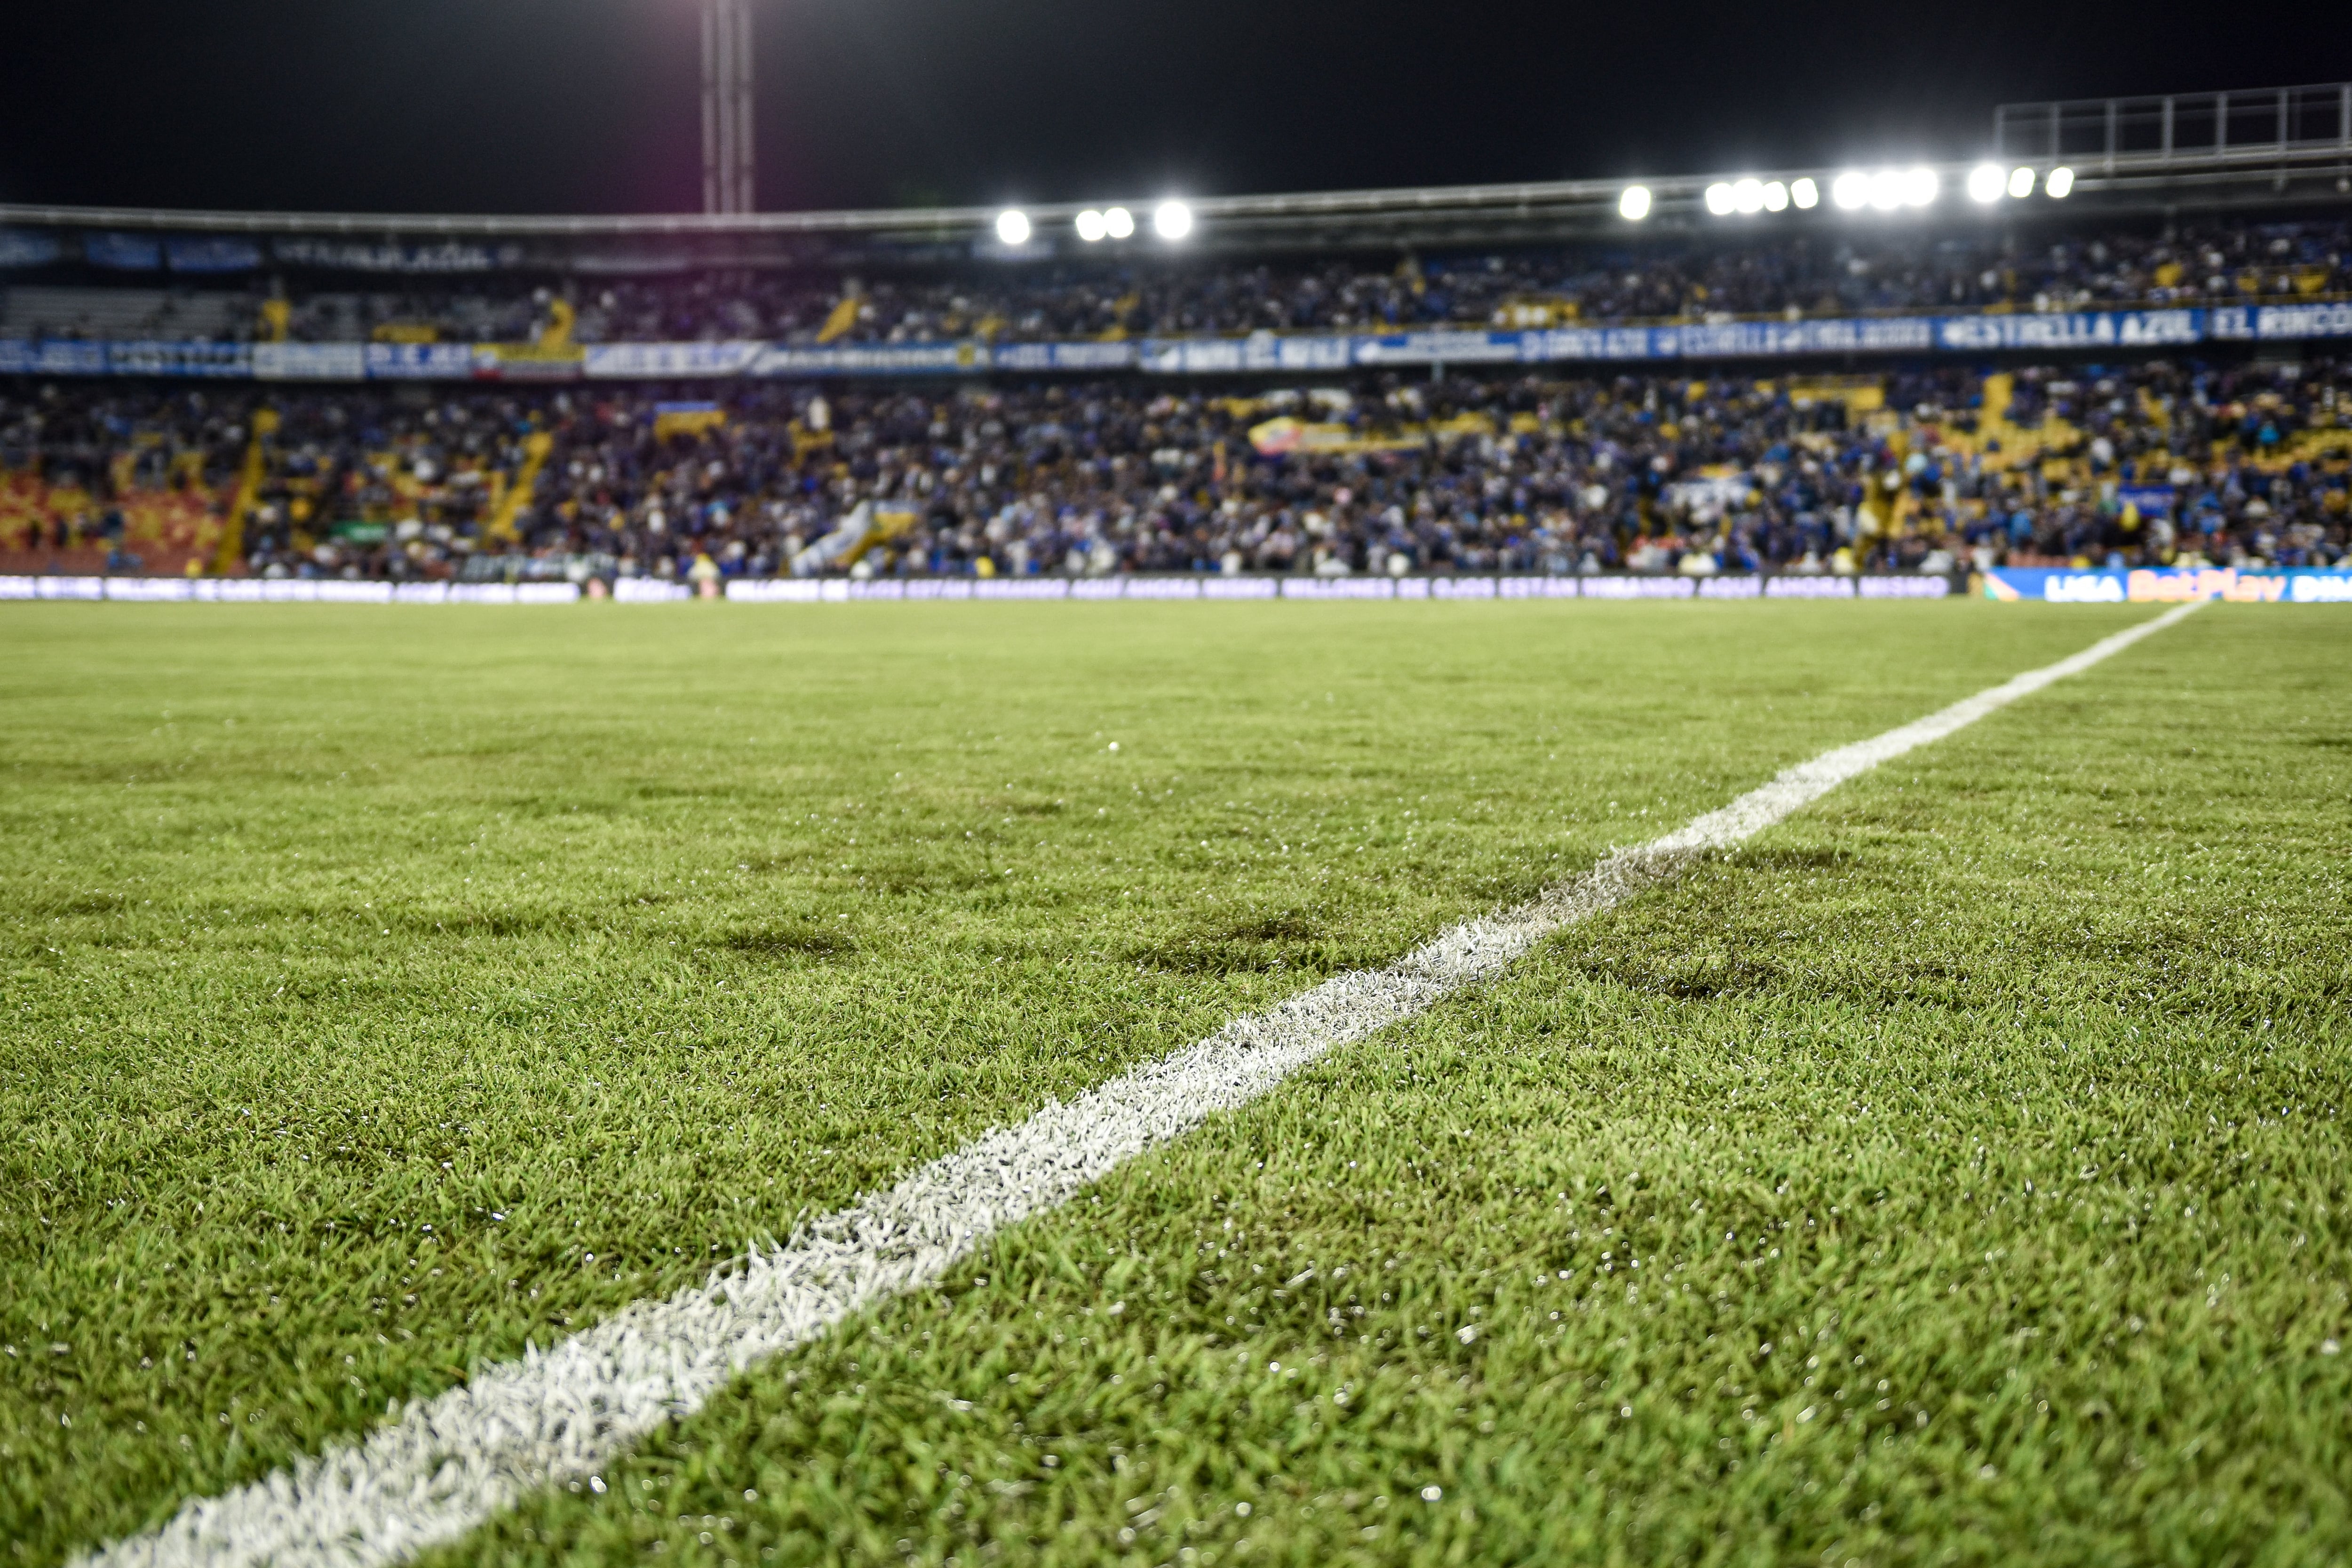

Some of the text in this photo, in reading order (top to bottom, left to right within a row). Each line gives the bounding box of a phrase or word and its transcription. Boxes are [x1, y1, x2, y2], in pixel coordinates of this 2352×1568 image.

[1963, 311, 2115, 347] ESTRELLA
[2120, 309, 2198, 344] AZUL
[2214, 307, 2255, 340] EL
[2044, 575, 2125, 602] LIGA
[2128, 569, 2287, 603] BetPlay
